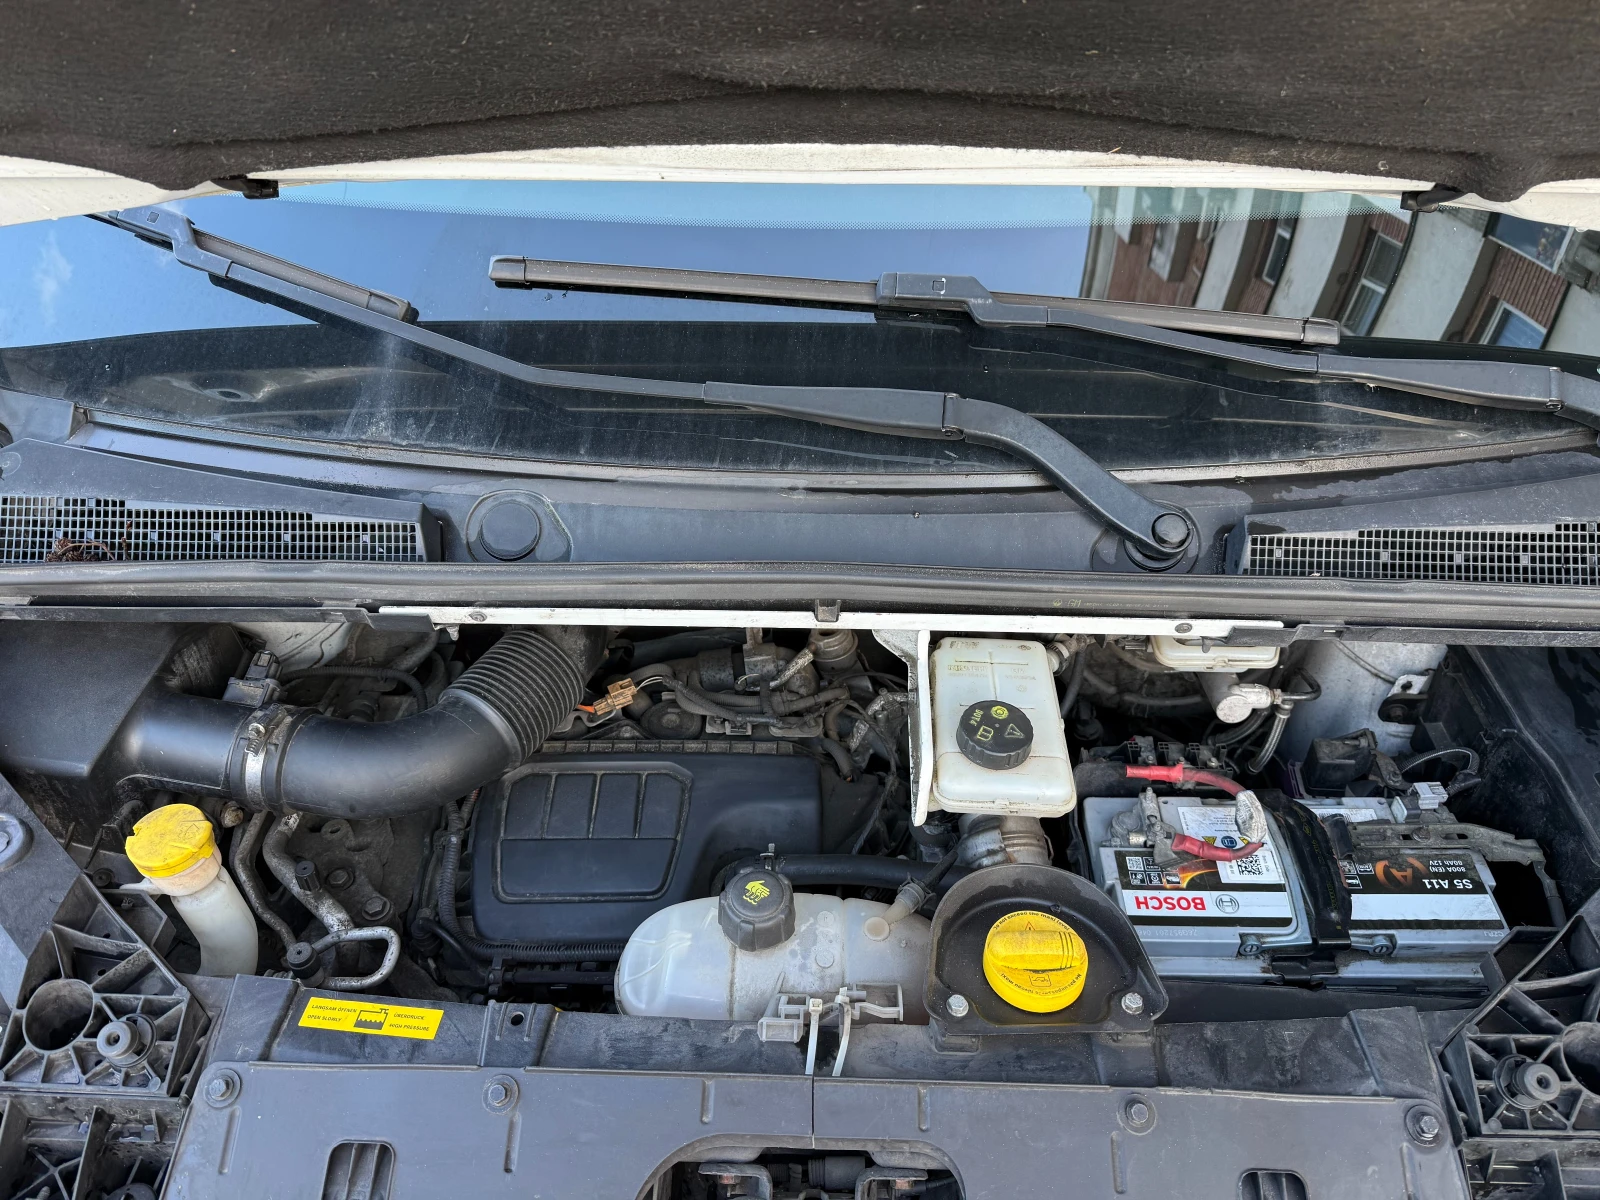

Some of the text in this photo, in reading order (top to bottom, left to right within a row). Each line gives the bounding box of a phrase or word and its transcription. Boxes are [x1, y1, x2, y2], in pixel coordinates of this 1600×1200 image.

[1422, 878, 1473, 889] S5 A11
[1134, 896, 1207, 911] BOSCH
[1040, 913, 1056, 922] maxi
[311, 1004, 337, 1012] LANGSAM
[403, 1024, 430, 1032] PRESSURE
